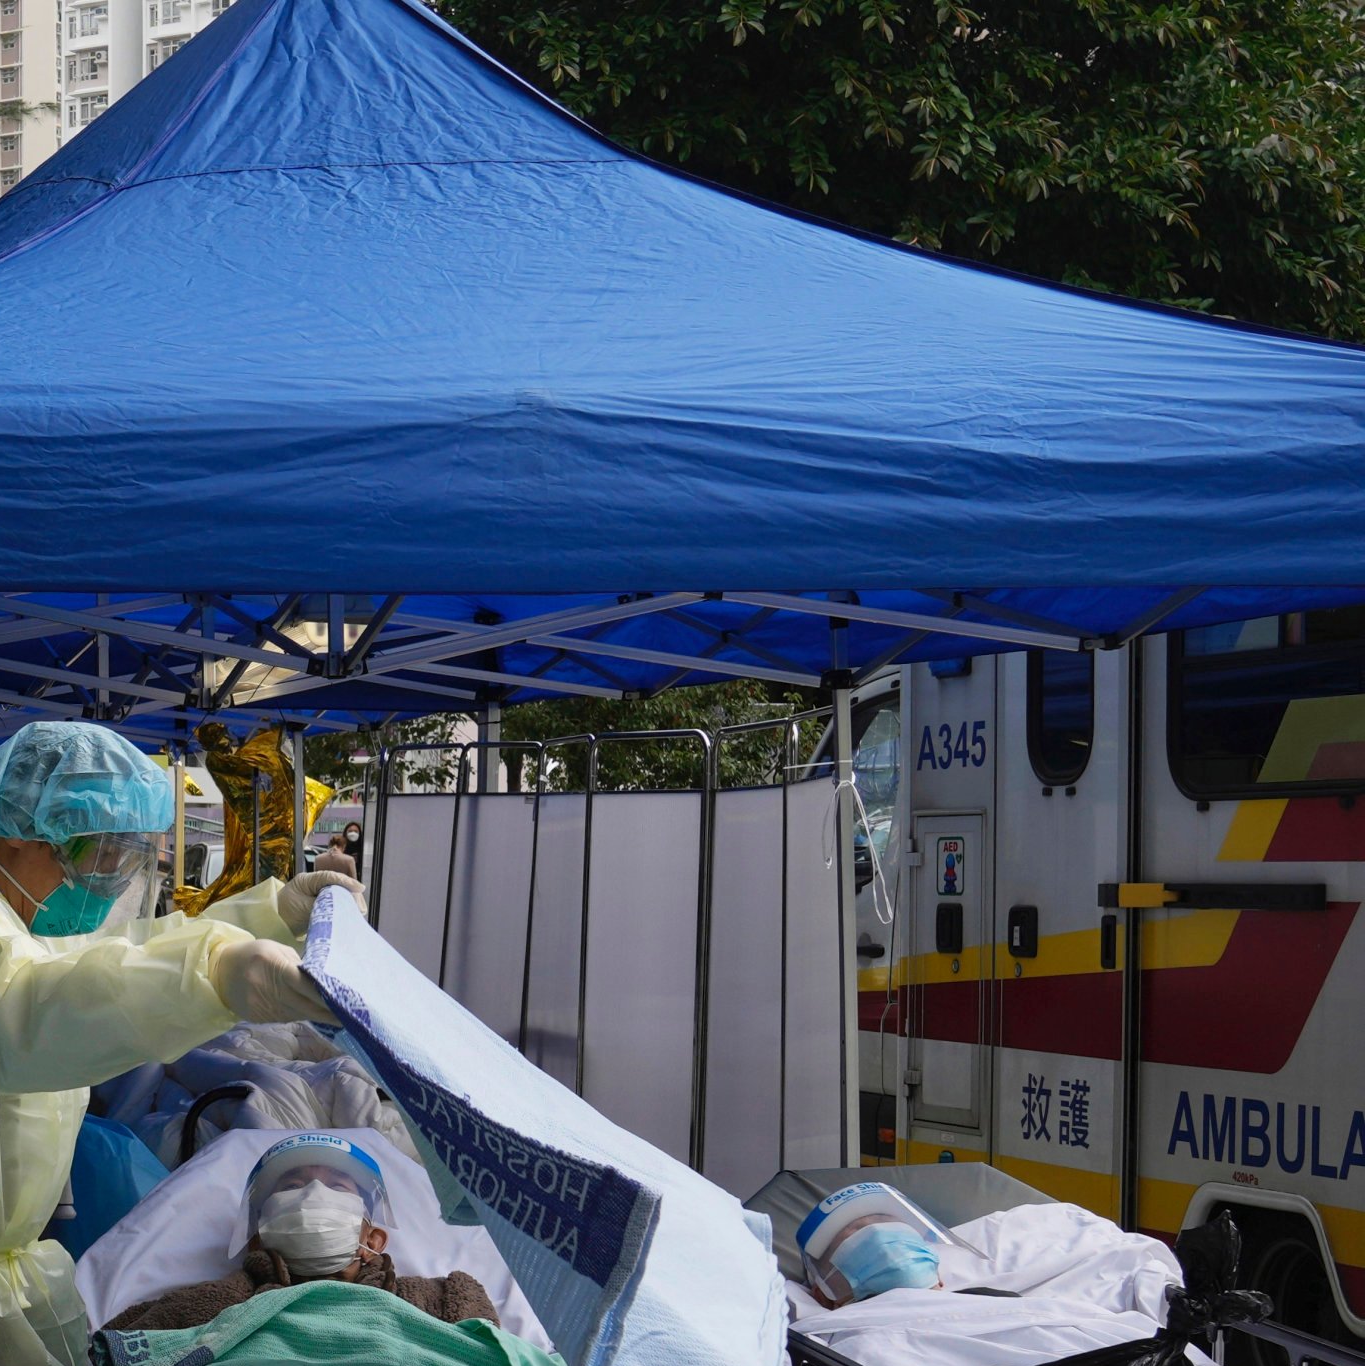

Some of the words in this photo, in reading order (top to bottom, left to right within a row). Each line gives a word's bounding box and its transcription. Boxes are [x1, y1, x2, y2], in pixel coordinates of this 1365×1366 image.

[917, 721, 986, 770] A345
[943, 842, 958, 852] AED
[1021, 1072, 1090, 1149] 救護
[298, 1135, 343, 1146] Shield
[1167, 1091, 1365, 1180] AMBULA
[1232, 1171, 1259, 1186] 420kPa
[825, 1188, 855, 1206] Face
